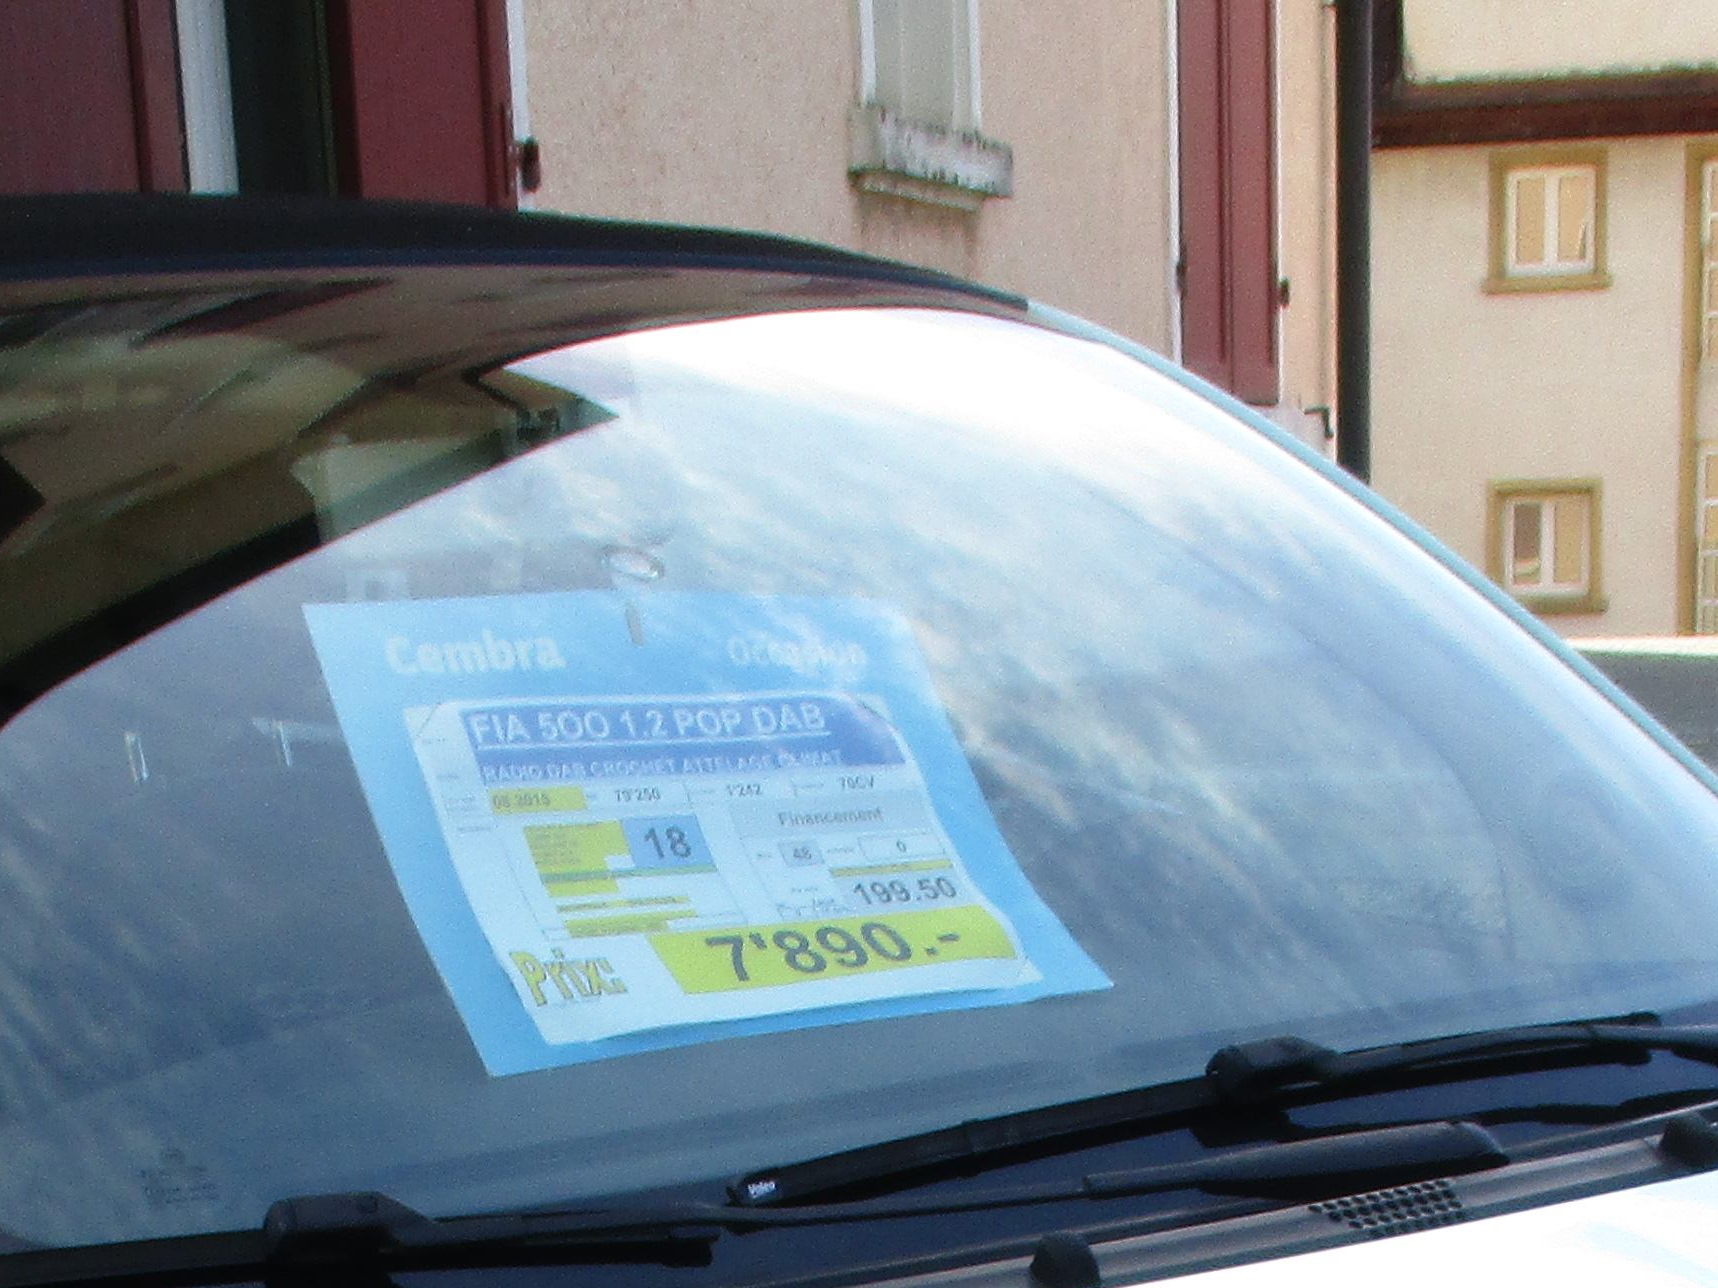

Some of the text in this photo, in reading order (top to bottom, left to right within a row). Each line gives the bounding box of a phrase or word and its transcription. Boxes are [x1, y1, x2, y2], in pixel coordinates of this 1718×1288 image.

[386, 628, 566, 676] Cembra
[469, 702, 826, 742] FIA 500 1.2 POP DAB
[777, 806, 884, 826] Financement
[644, 825, 692, 859] 18
[853, 876, 958, 905] 199.50
[705, 921, 960, 983] 7'890.-
[509, 948, 628, 1007] Prix:
